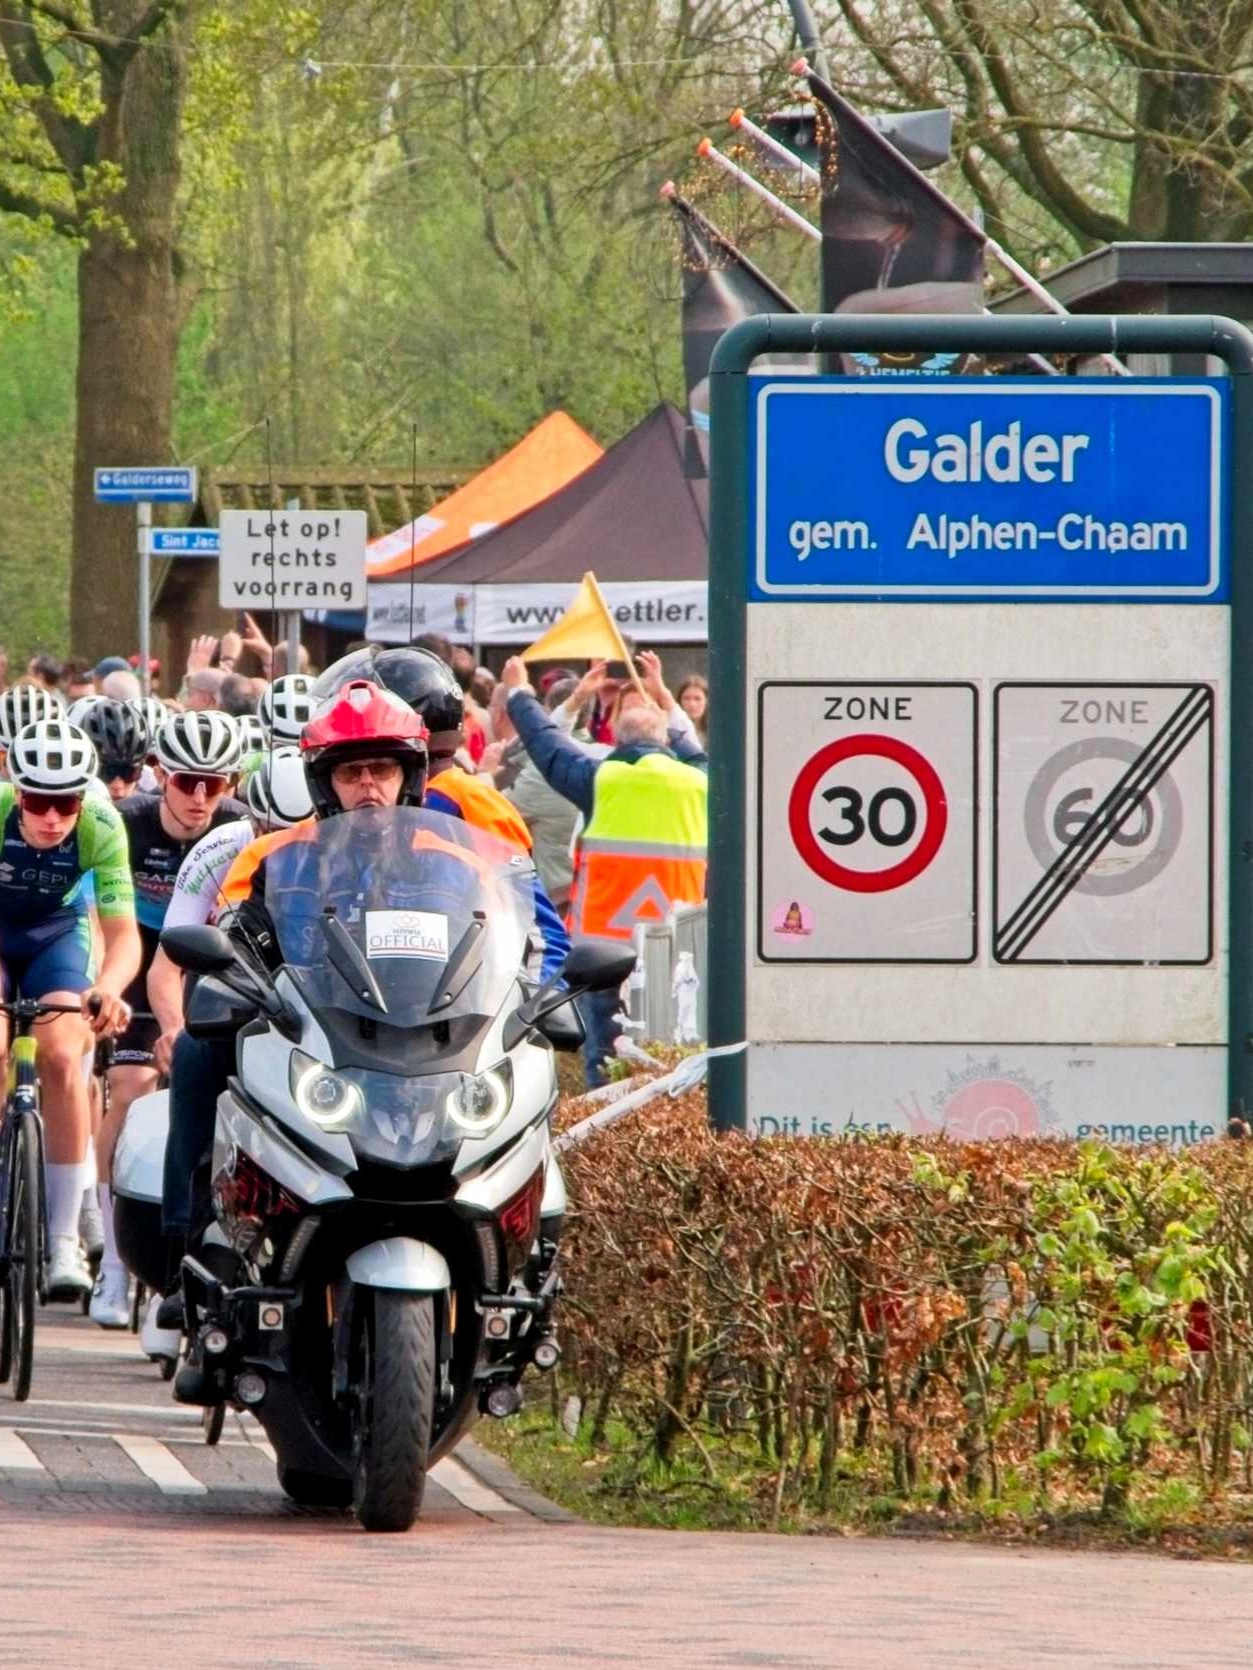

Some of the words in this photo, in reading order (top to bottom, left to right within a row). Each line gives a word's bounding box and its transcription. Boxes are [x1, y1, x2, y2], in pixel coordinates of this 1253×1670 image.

[884, 418, 1090, 484] Galder
[161, 534, 188, 547] Sint
[247, 519, 288, 538] Let
[300, 518, 340, 541] op!
[789, 520, 879, 561] gem.
[907, 512, 1188, 559] Alphen-Chaam
[251, 547, 336, 567] rechts
[233, 581, 353, 601] voorrang
[823, 696, 913, 721] ZONE
[1059, 699, 1150, 725] ZONE
[817, 786, 918, 847] 30
[1052, 787, 1155, 848] 60
[369, 935, 443, 951] OFFICIAL
[759, 1115, 801, 1137] Dit
[811, 1116, 832, 1137] is
[1076, 1119, 1215, 1144] gemeente
